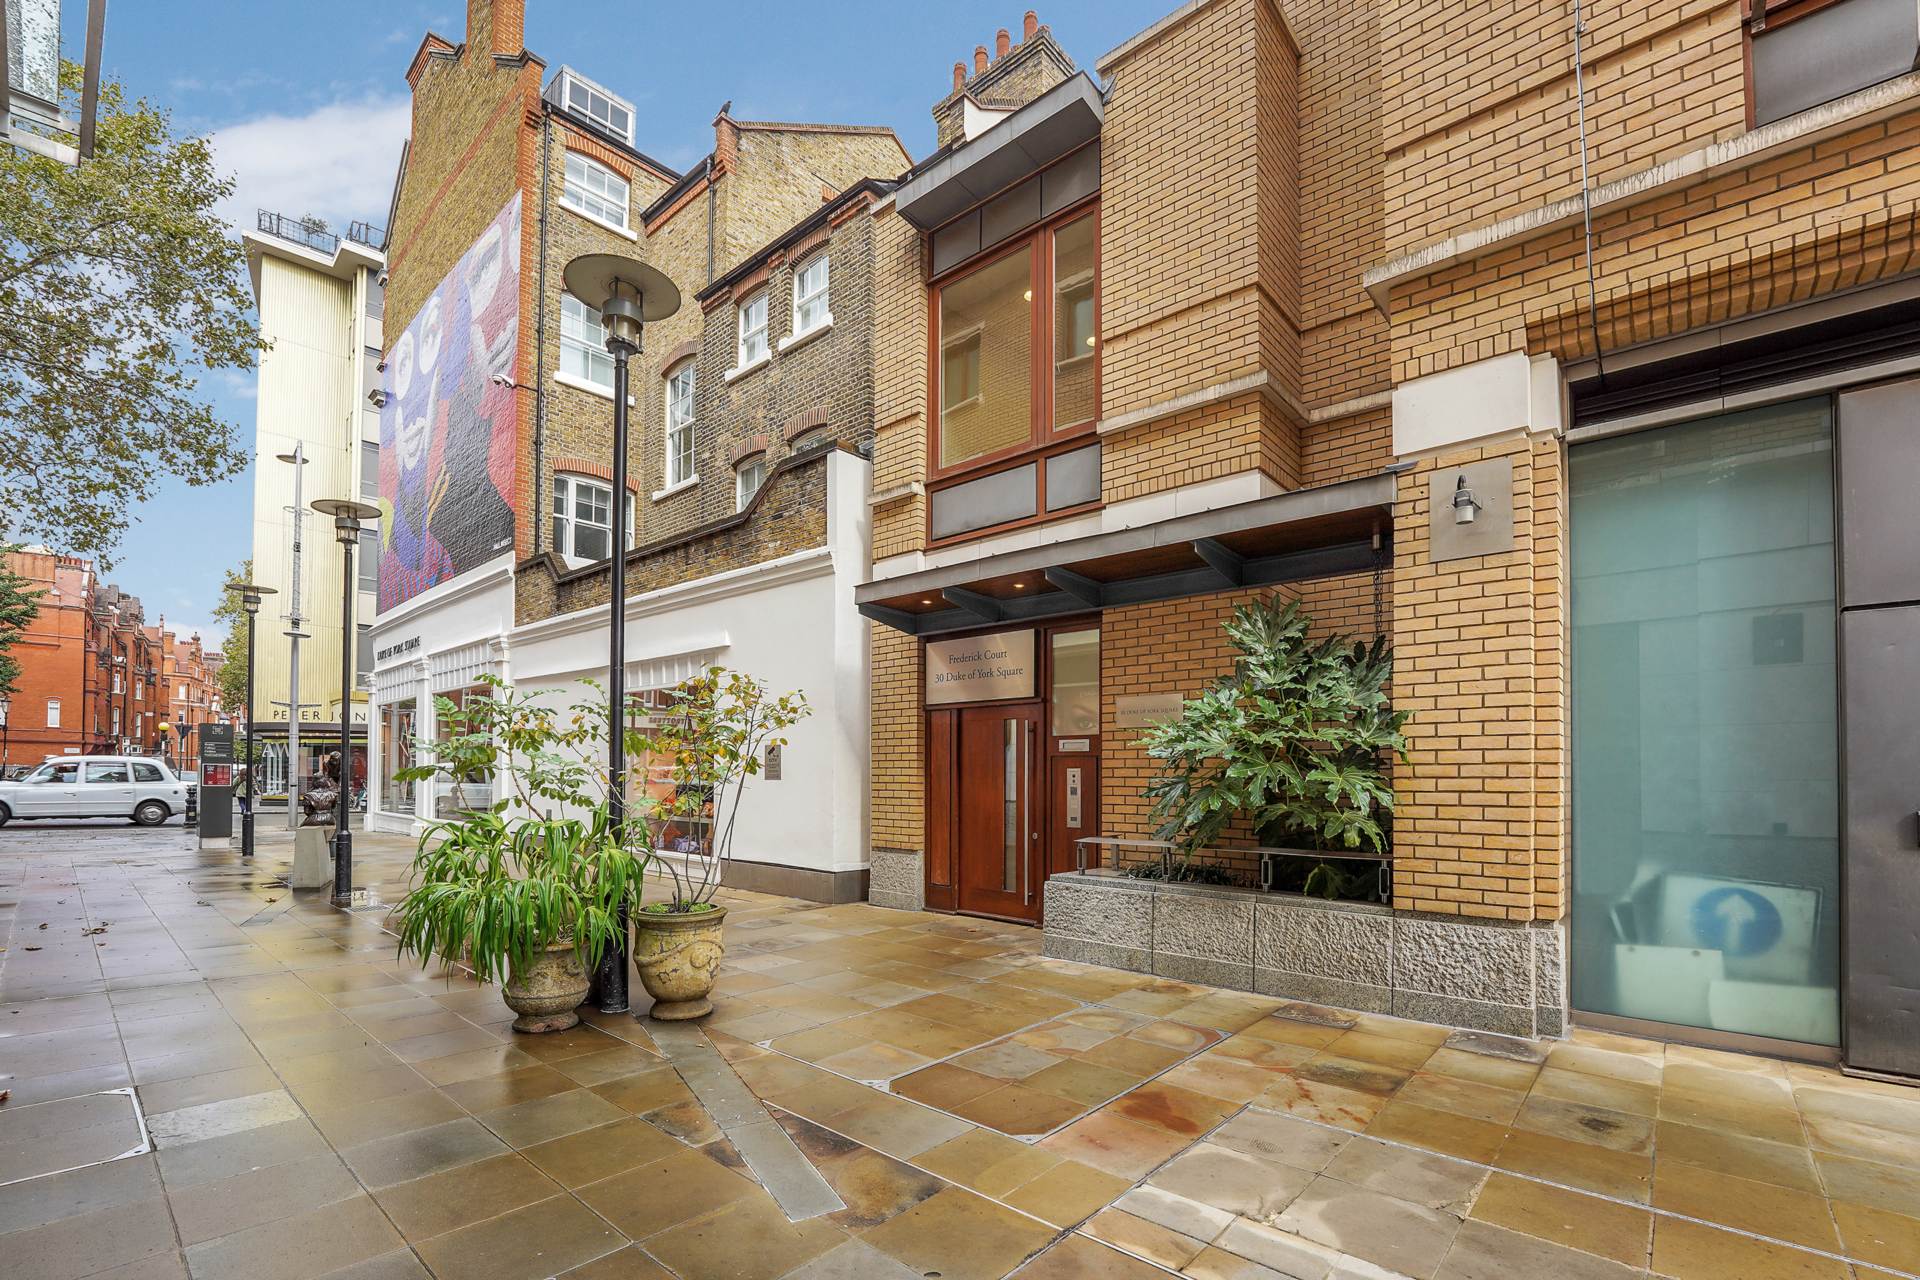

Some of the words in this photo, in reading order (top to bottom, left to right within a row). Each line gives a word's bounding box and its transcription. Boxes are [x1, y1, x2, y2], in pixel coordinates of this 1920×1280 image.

[948, 652, 982, 665] Frederick
[983, 649, 1008, 660] Court
[935, 673, 944, 684] 30
[946, 671, 966, 682] Duke
[967, 670, 976, 680] of
[977, 667, 994, 679] York
[996, 666, 1024, 680] Square
[273, 710, 321, 720] PEER
